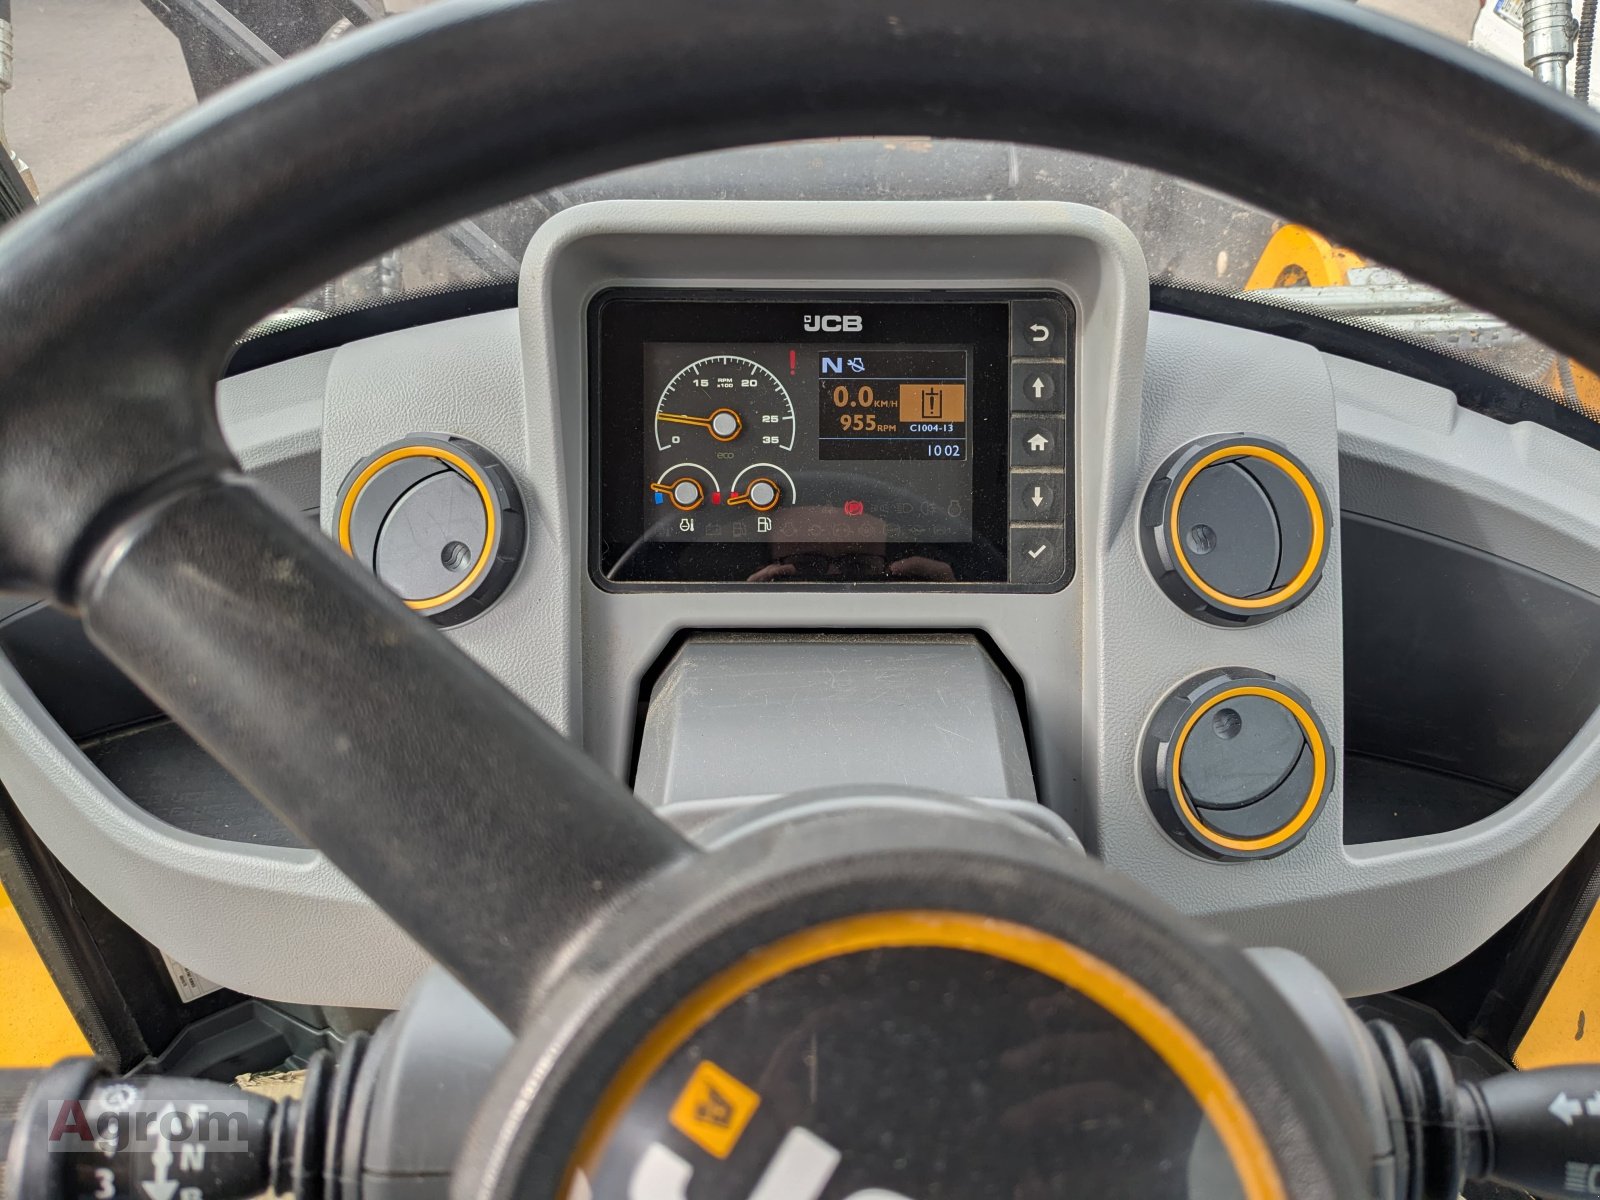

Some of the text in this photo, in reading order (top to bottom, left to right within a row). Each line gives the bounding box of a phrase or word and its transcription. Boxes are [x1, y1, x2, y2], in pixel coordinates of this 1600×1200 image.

[804, 314, 863, 333] JCB
[822, 357, 843, 374] N
[692, 379, 709, 387] 15
[741, 379, 758, 387] 20
[833, 385, 898, 408] 0.0 KM/H
[761, 415, 779, 423] 25
[840, 414, 897, 432] 955 RPM
[671, 435, 681, 444] 0
[762, 436, 780, 444] 35
[179, 1142, 207, 1171] N
[94, 1168, 117, 1199] 3
